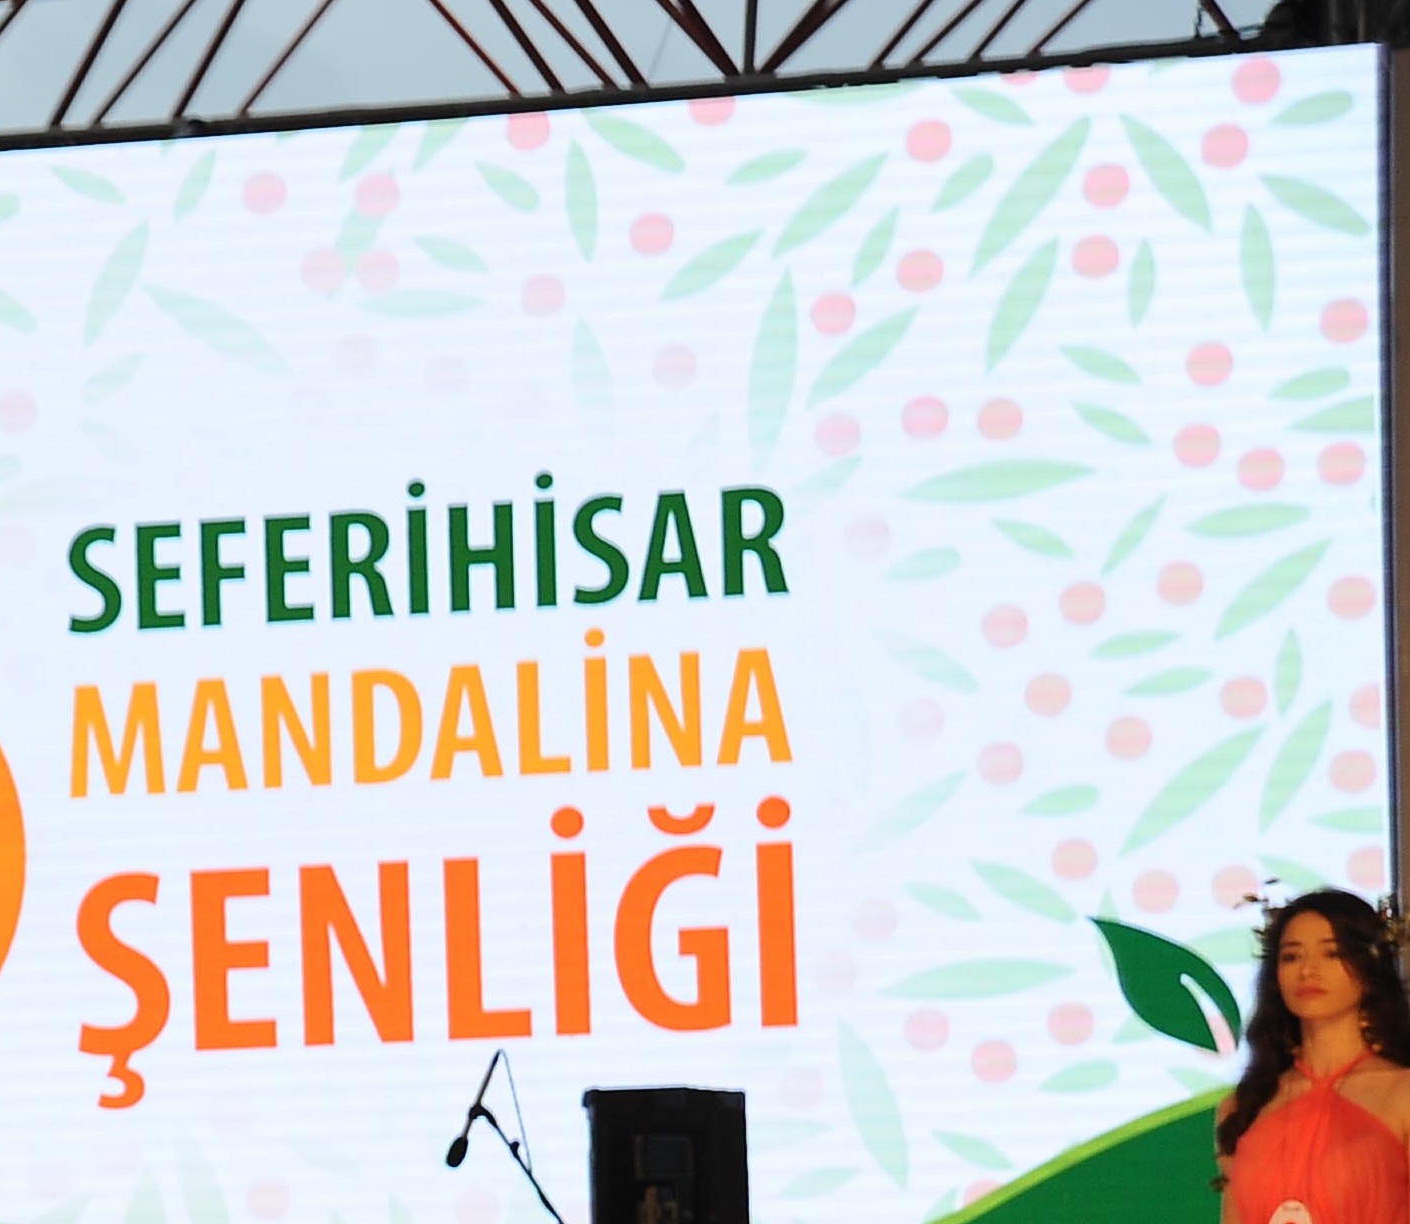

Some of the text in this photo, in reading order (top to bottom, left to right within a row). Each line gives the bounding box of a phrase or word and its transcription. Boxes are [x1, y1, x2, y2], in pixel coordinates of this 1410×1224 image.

[67, 472, 791, 634] SEFERİHİSAR
[69, 626, 794, 799] MANDALİNA
[75, 794, 799, 1111] ŞENLİĞİ
